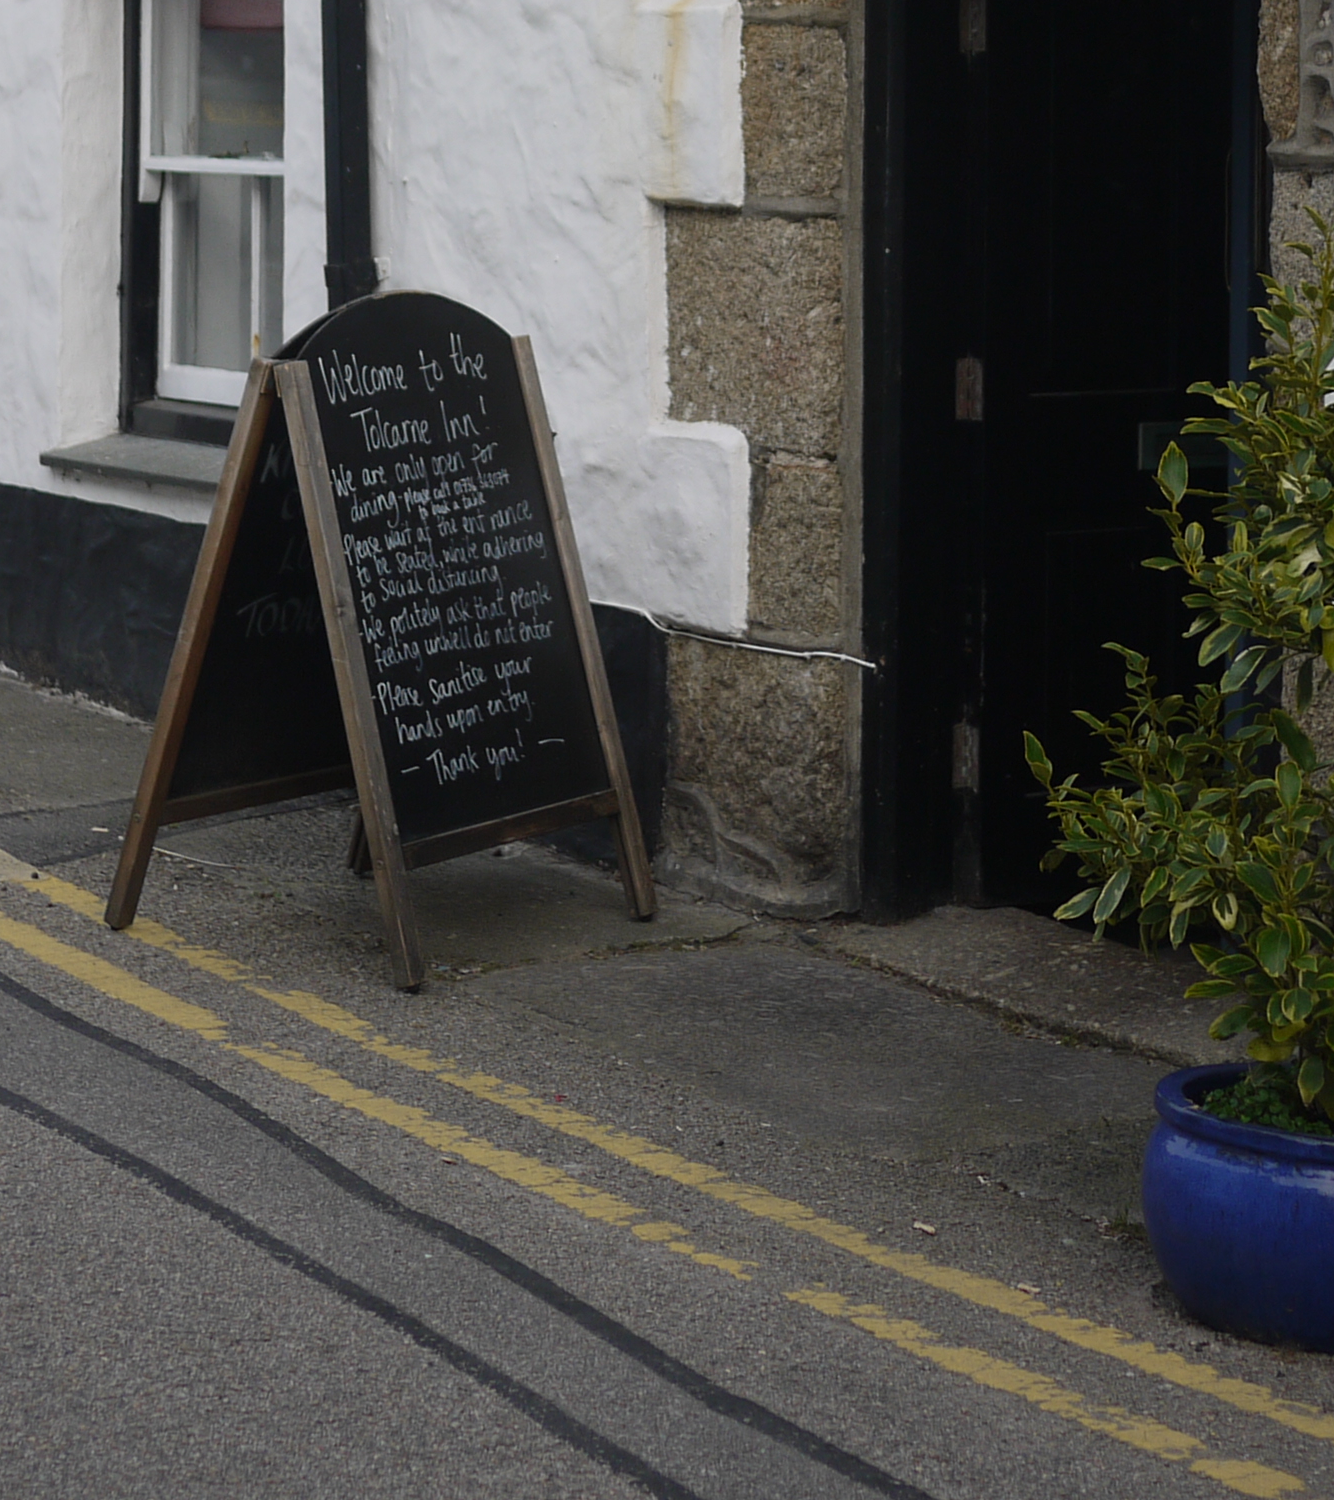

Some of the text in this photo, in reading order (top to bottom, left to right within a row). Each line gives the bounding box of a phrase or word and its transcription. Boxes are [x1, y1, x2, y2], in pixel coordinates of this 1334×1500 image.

[318, 332, 487, 405] Welcome to the
[350, 395, 490, 452] Tolcarne Inn!
[362, 465, 387, 487] are
[395, 453, 431, 490] only
[431, 451, 466, 486] open
[471, 442, 498, 477] for
[433, 480, 451, 499] call
[453, 501, 460, 510] a
[343, 532, 382, 566] Please
[385, 521, 411, 550] wait
[417, 522, 432, 544] at
[437, 516, 458, 537] the
[357, 566, 371, 588] to
[375, 553, 391, 575] be
[483, 529, 546, 560] adhering
[361, 590, 377, 614] to
[390, 598, 443, 647] politely
[446, 600, 473, 625] ask
[474, 589, 506, 620] that
[510, 581, 553, 617] people
[374, 617, 554, 673] feeling unwell do not enter
[494, 656, 533, 696] your
[395, 710, 443, 745] hands
[447, 704, 484, 733] upon
[426, 728, 525, 785] Thank you!
